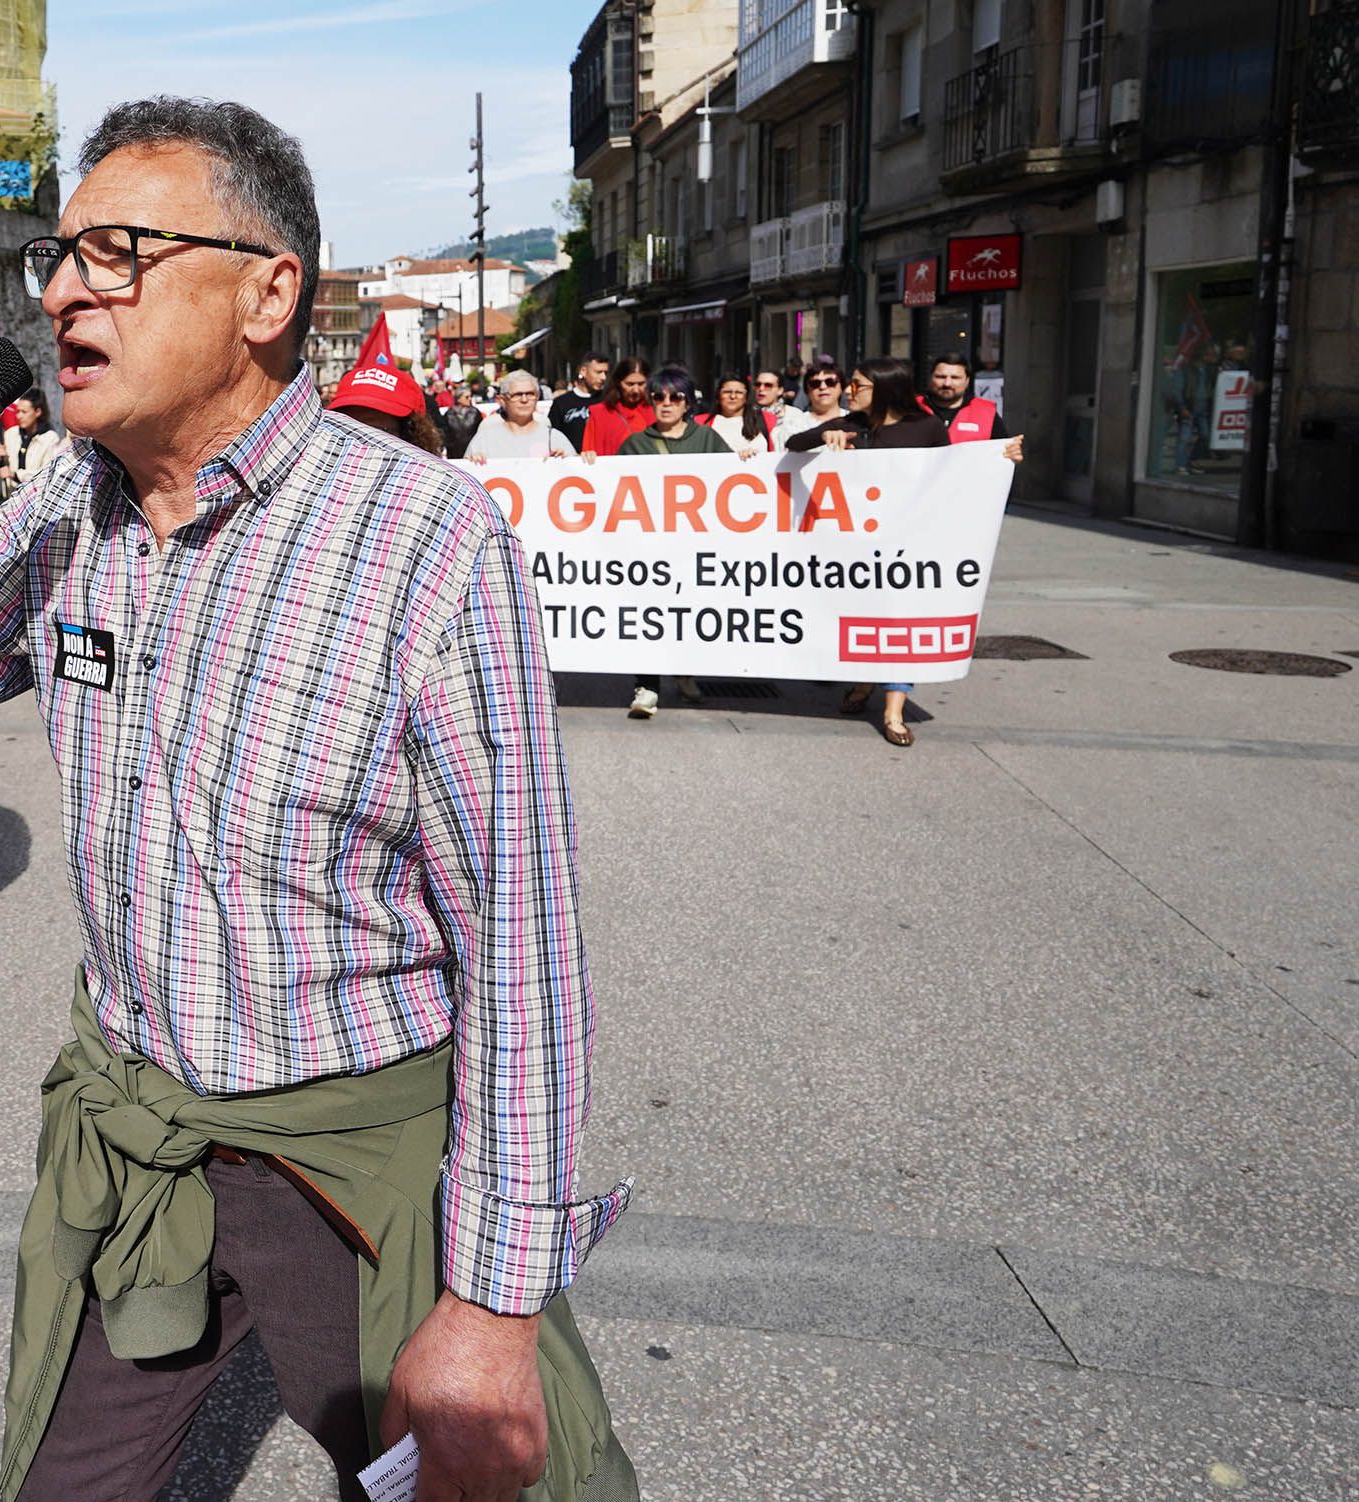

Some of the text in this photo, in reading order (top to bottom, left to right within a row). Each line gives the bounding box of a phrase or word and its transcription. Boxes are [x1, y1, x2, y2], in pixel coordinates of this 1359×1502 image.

[948, 267, 1018, 281] Fluchos
[904, 290, 936, 304] Fluchos
[354, 367, 399, 387] CCOO
[533, 549, 981, 596] Abusos, Explotación e
[544, 605, 804, 644] TIC ESTORES
[63, 633, 84, 656] NON
[848, 625, 972, 655] CCOO
[63, 655, 108, 686] GUERRA
